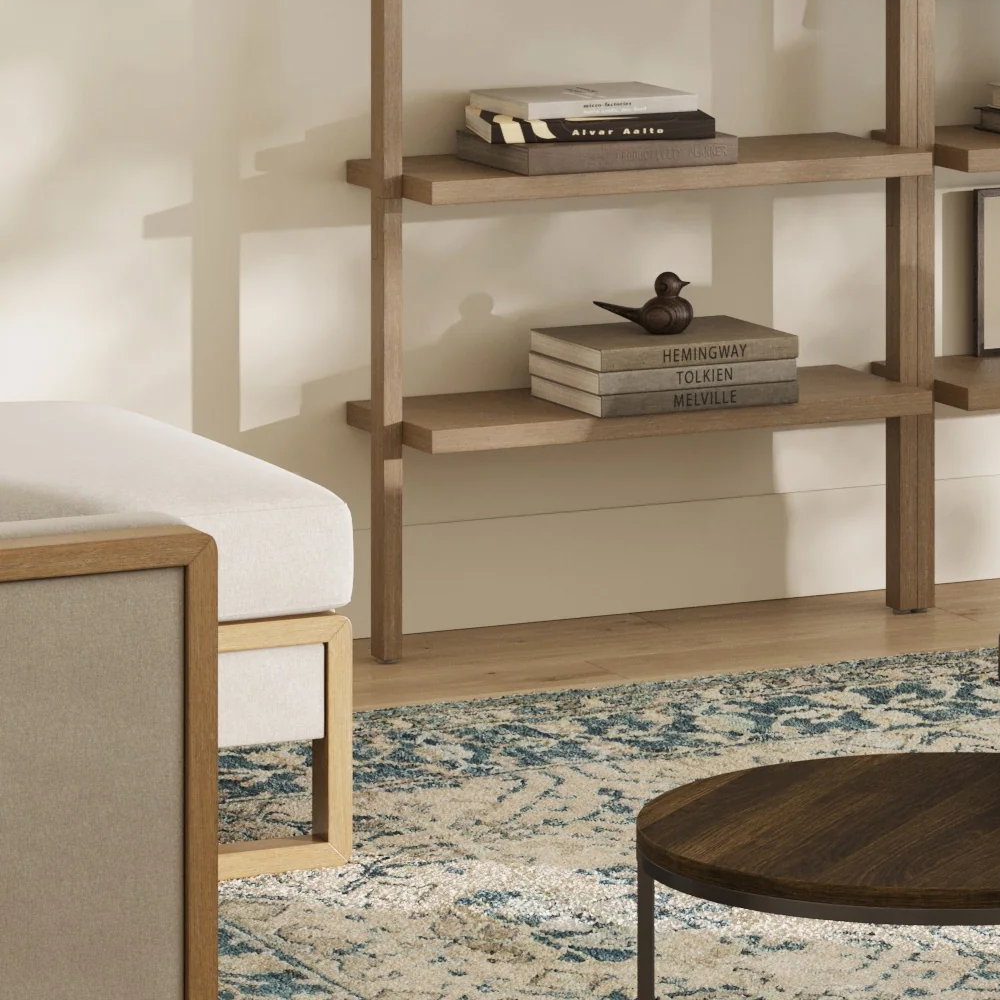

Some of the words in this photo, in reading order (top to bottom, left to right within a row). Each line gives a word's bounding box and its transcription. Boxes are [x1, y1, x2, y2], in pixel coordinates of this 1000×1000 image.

[572, 127, 614, 136] Alvar
[622, 126, 664, 135] Aalto
[662, 344, 748, 364] HEMINGWAY
[676, 367, 734, 385] TOLKIEN
[673, 389, 738, 408] MELVILLE
